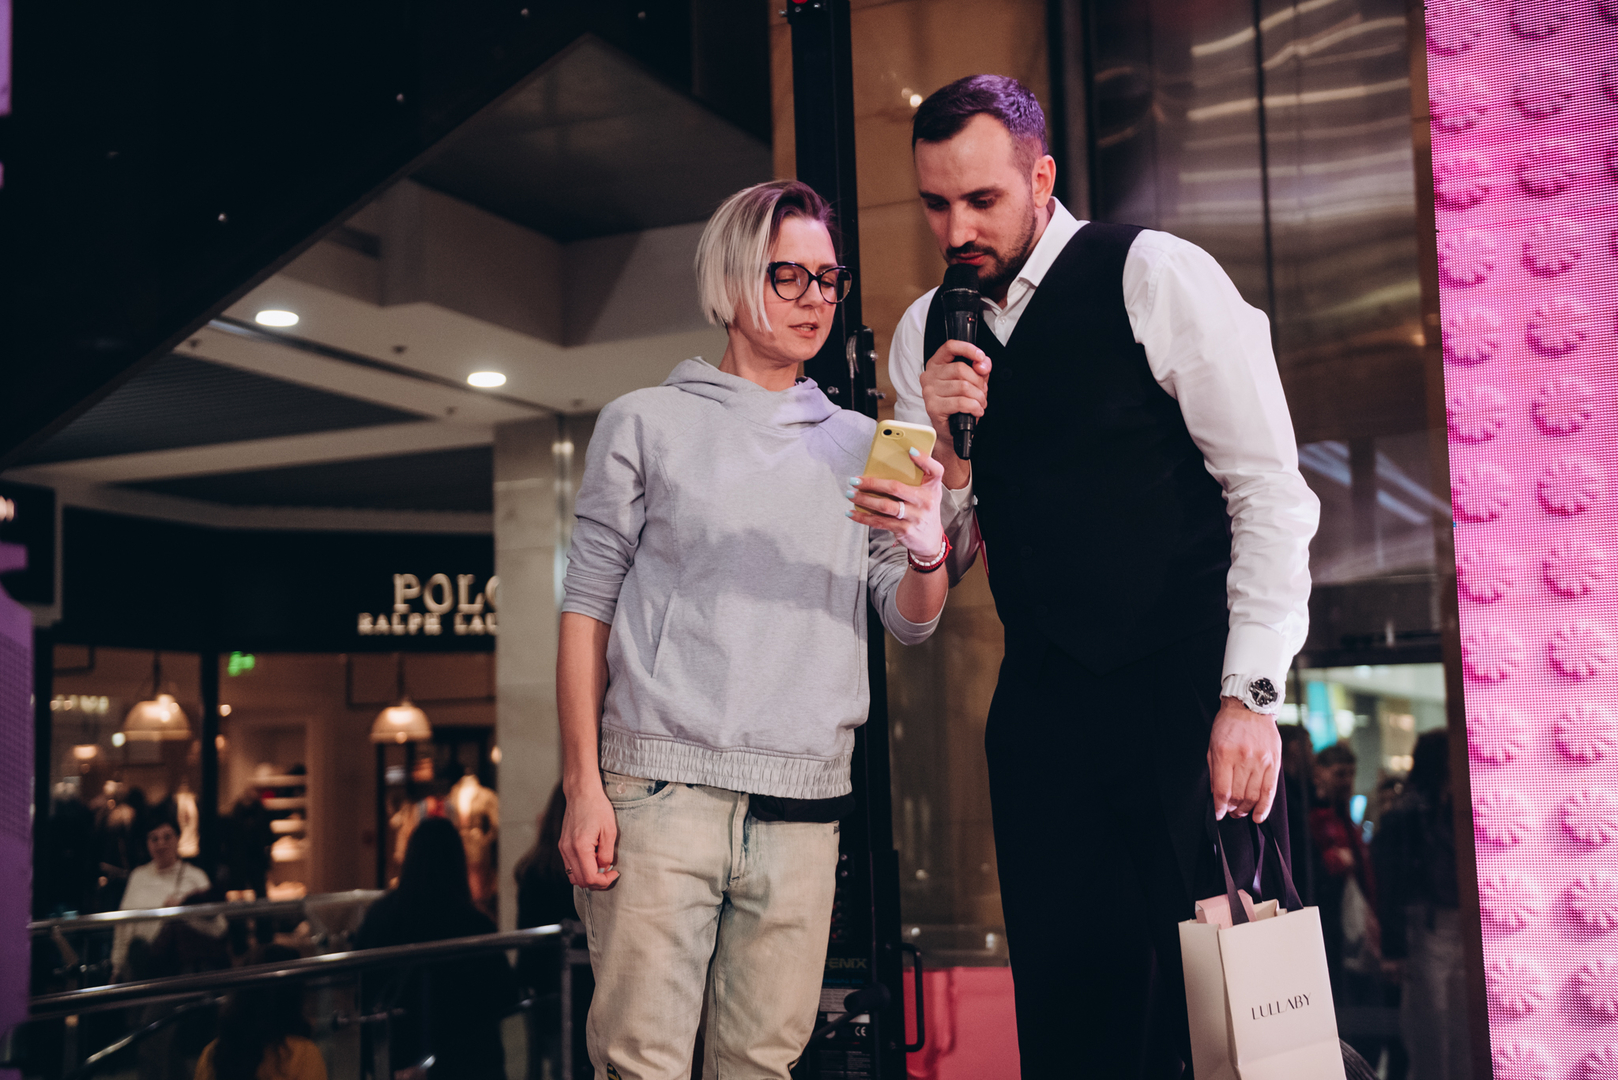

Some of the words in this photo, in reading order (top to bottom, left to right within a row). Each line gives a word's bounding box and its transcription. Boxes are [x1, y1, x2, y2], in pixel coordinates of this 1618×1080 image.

[357, 612, 443, 636] RALPH
[826, 957, 867, 969] ENIX
[1251, 992, 1312, 1020] LULLABY
[855, 1026, 867, 1036] CE
